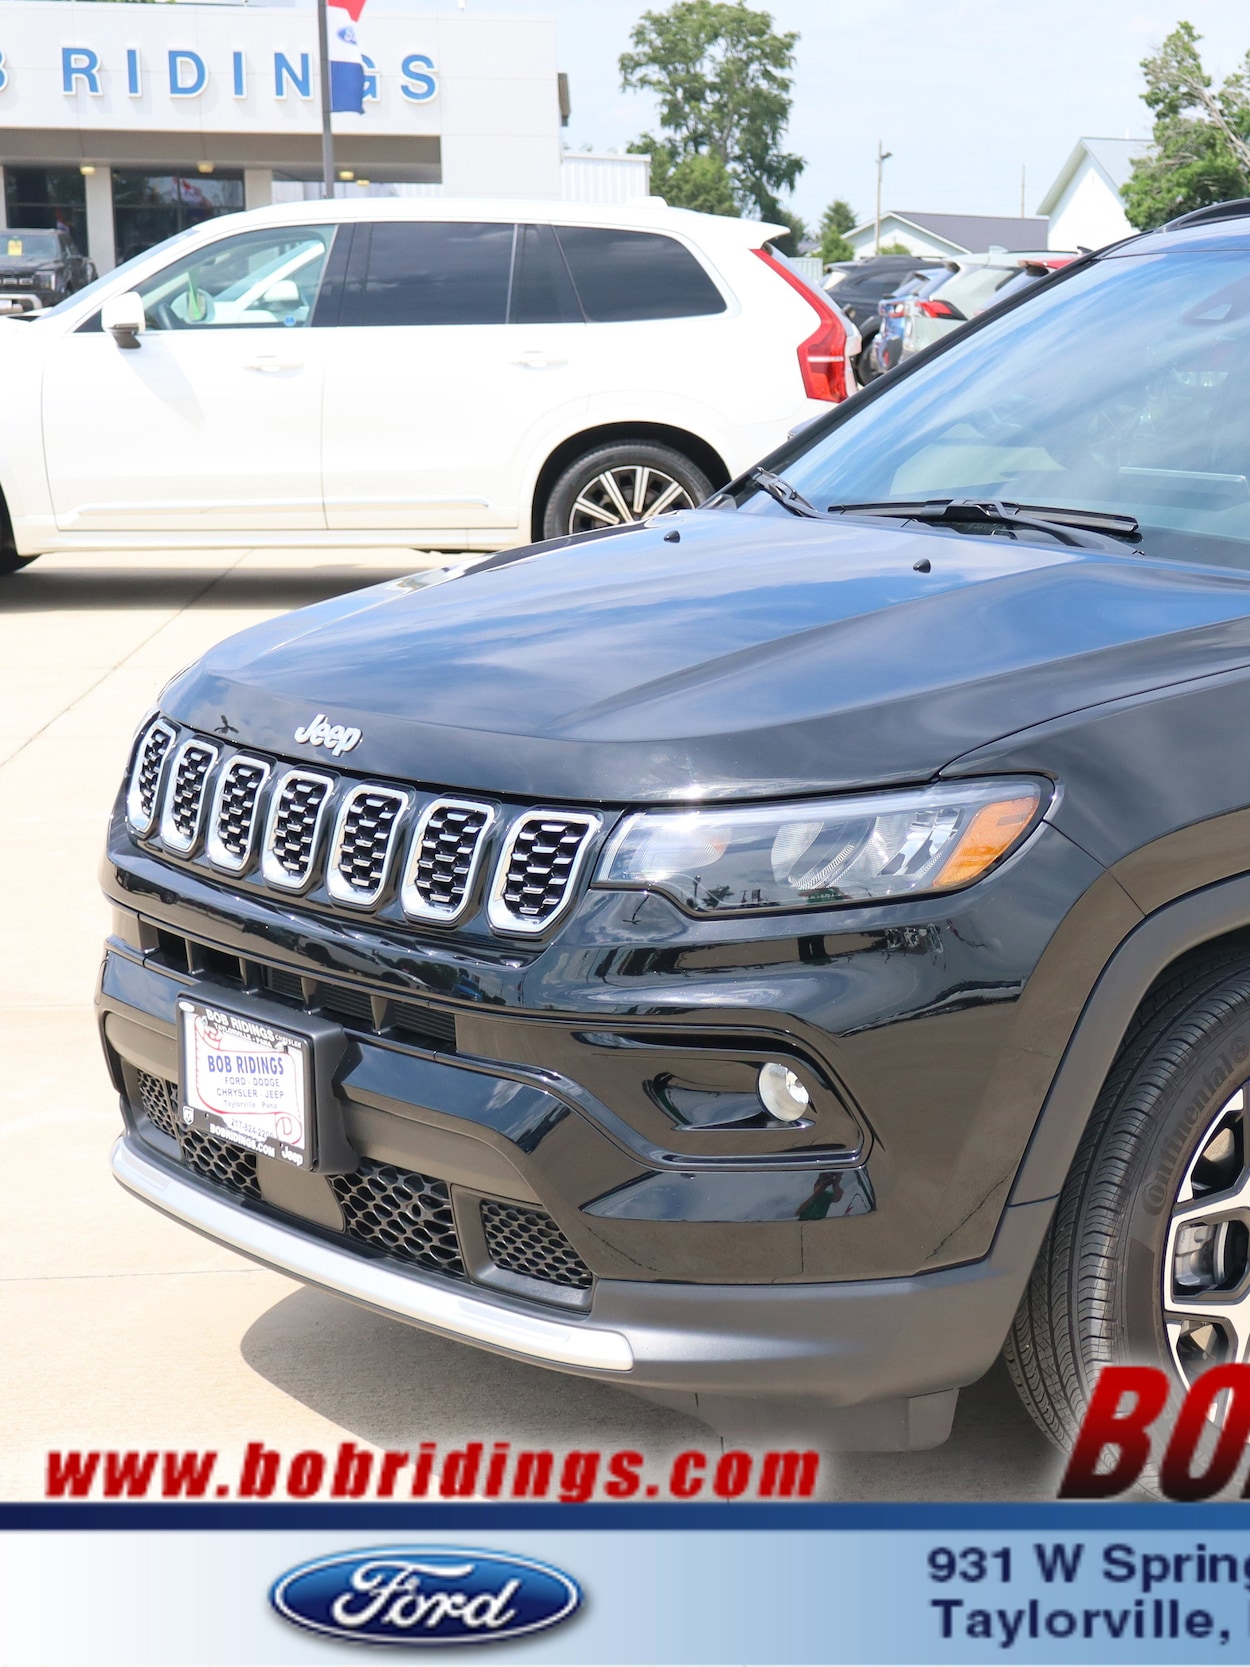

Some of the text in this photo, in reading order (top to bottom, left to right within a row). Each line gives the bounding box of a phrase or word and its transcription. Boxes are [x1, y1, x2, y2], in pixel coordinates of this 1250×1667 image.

[294, 713, 363, 757] Jeep
[205, 1008, 275, 1042] BOB RIDINGS
[207, 1055, 284, 1075] BOB RIDINGS
[224, 1076, 280, 1088] FORD DODGE
[216, 1088, 284, 1099] CHRYSLER JEEP
[209, 1123, 275, 1158] BOBRIDINGS.COM
[281, 1146, 304, 1166] Jeep
